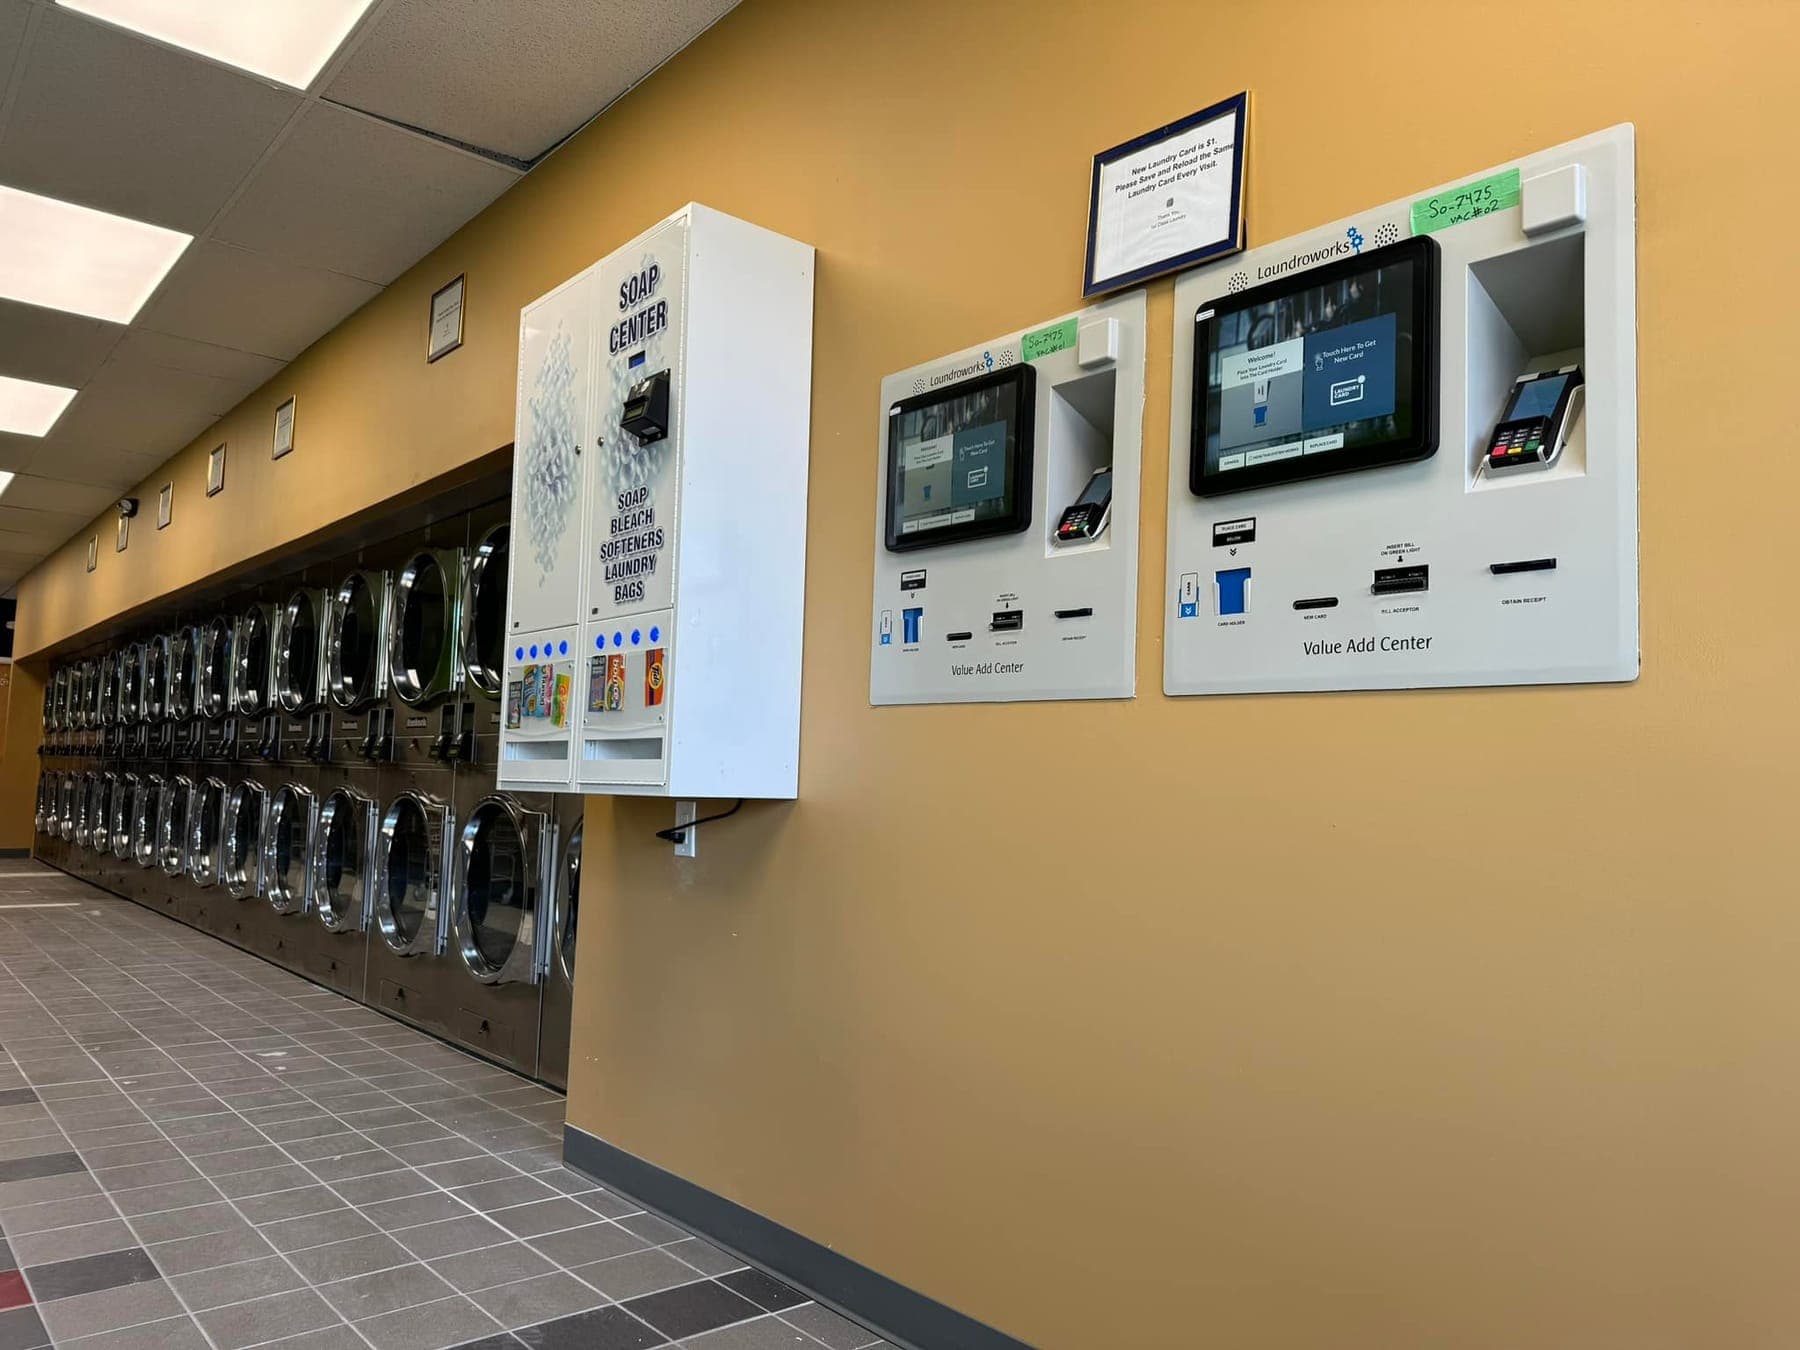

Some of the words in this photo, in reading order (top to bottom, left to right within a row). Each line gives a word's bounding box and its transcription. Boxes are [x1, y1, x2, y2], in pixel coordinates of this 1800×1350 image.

[1114, 180, 1138, 192] Please
[1138, 173, 1156, 184] Save
[1158, 165, 1171, 176] and
[1172, 155, 1198, 171] Reload
[1200, 152, 1212, 161] the
[1213, 144, 1234, 156] Same
[1132, 166, 1146, 176] New
[1148, 154, 1177, 170] Laundry
[1178, 145, 1196, 158] Card
[1206, 138, 1218, 147] $1.
[1128, 184, 1156, 198] Laundry
[1158, 175, 1175, 188] Card
[1176, 168, 1198, 180] Every
[1199, 160, 1218, 172] Visit.
[1258, 240, 1350, 280] Laundroworks
[619, 264, 659, 310] SOAP
[610, 300, 667, 354] CENTER
[1323, 349, 1340, 358] Touch
[1340, 346, 1356, 354] Here
[1364, 340, 1376, 348] Get
[1334, 356, 1348, 364] New
[1348, 350, 1364, 360] Card
[930, 360, 985, 386] Laundroworks
[618, 486, 648, 510] SOAP
[610, 508, 654, 534] BLEACH
[600, 528, 663, 560] SOFTENERS
[604, 554, 656, 580] LAUNDRY
[614, 580, 644, 601] BAGS
[1502, 598, 1522, 606] OBTAIN
[1523, 596, 1546, 604] RECEIPT
[1304, 640, 1342, 655] Value
[1346, 636, 1375, 653] Add
[1380, 636, 1432, 652] Center
[952, 664, 974, 676] Value
[976, 662, 992, 674] Add
[994, 662, 1024, 674] Center
